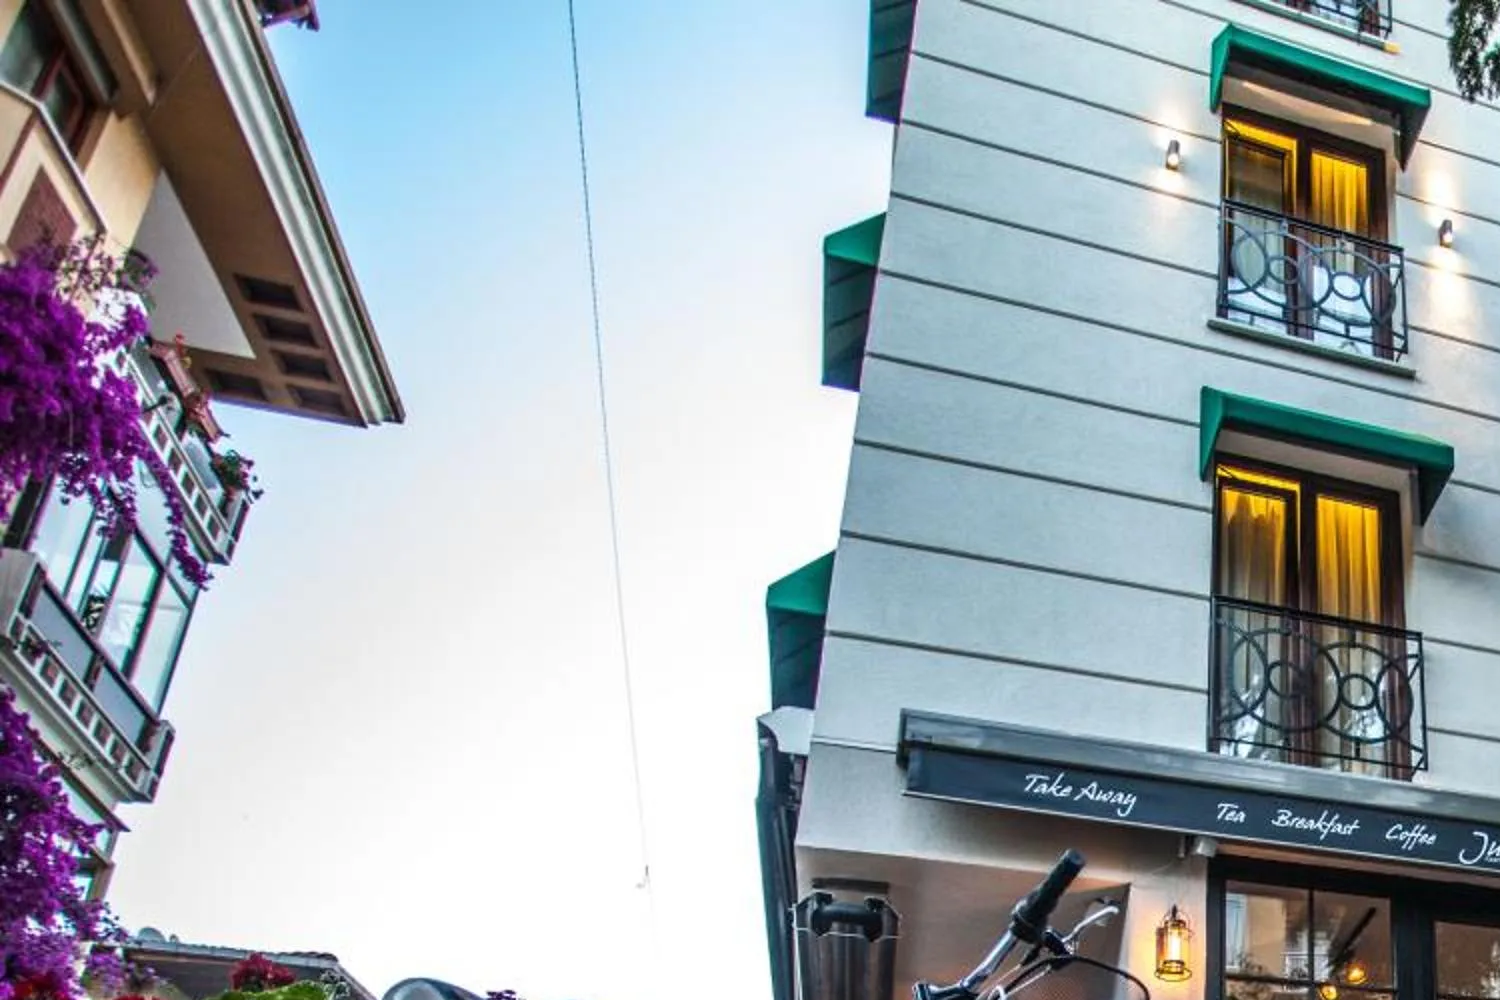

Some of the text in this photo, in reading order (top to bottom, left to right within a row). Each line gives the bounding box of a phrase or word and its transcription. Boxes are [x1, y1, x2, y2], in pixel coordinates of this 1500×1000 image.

[1024, 771, 1073, 797] Take
[1073, 781, 1137, 817] Away
[1217, 803, 1246, 823] Tea
[1271, 809, 1360, 840] Breakfast
[1385, 823, 1437, 850] Coffee
